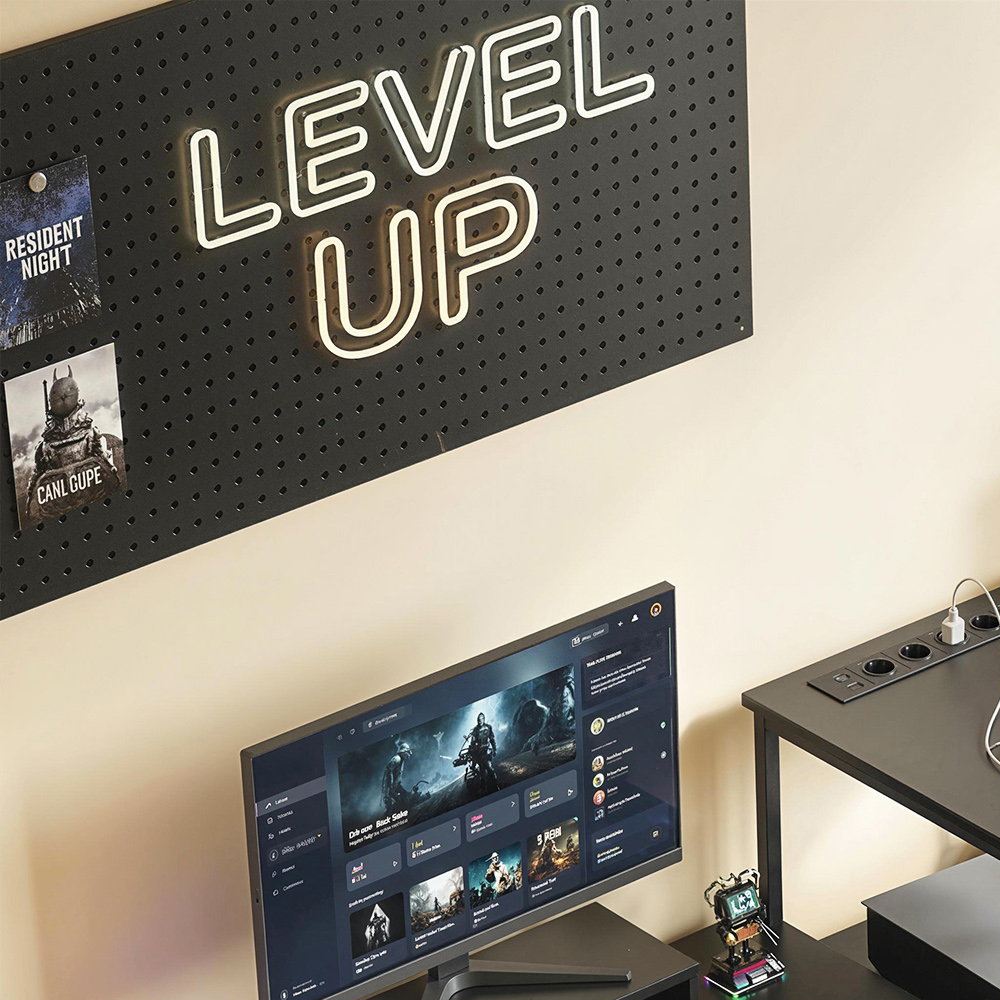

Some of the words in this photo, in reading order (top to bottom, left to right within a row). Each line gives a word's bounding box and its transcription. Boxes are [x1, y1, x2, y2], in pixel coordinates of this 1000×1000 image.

[190, 4, 655, 249] LEVEL
[5, 215, 83, 262] RESIDENT
[21, 243, 72, 280] NIGHT
[314, 175, 539, 359] UP
[37, 479, 69, 505] CANL
[69, 465, 103, 493] GUPE
